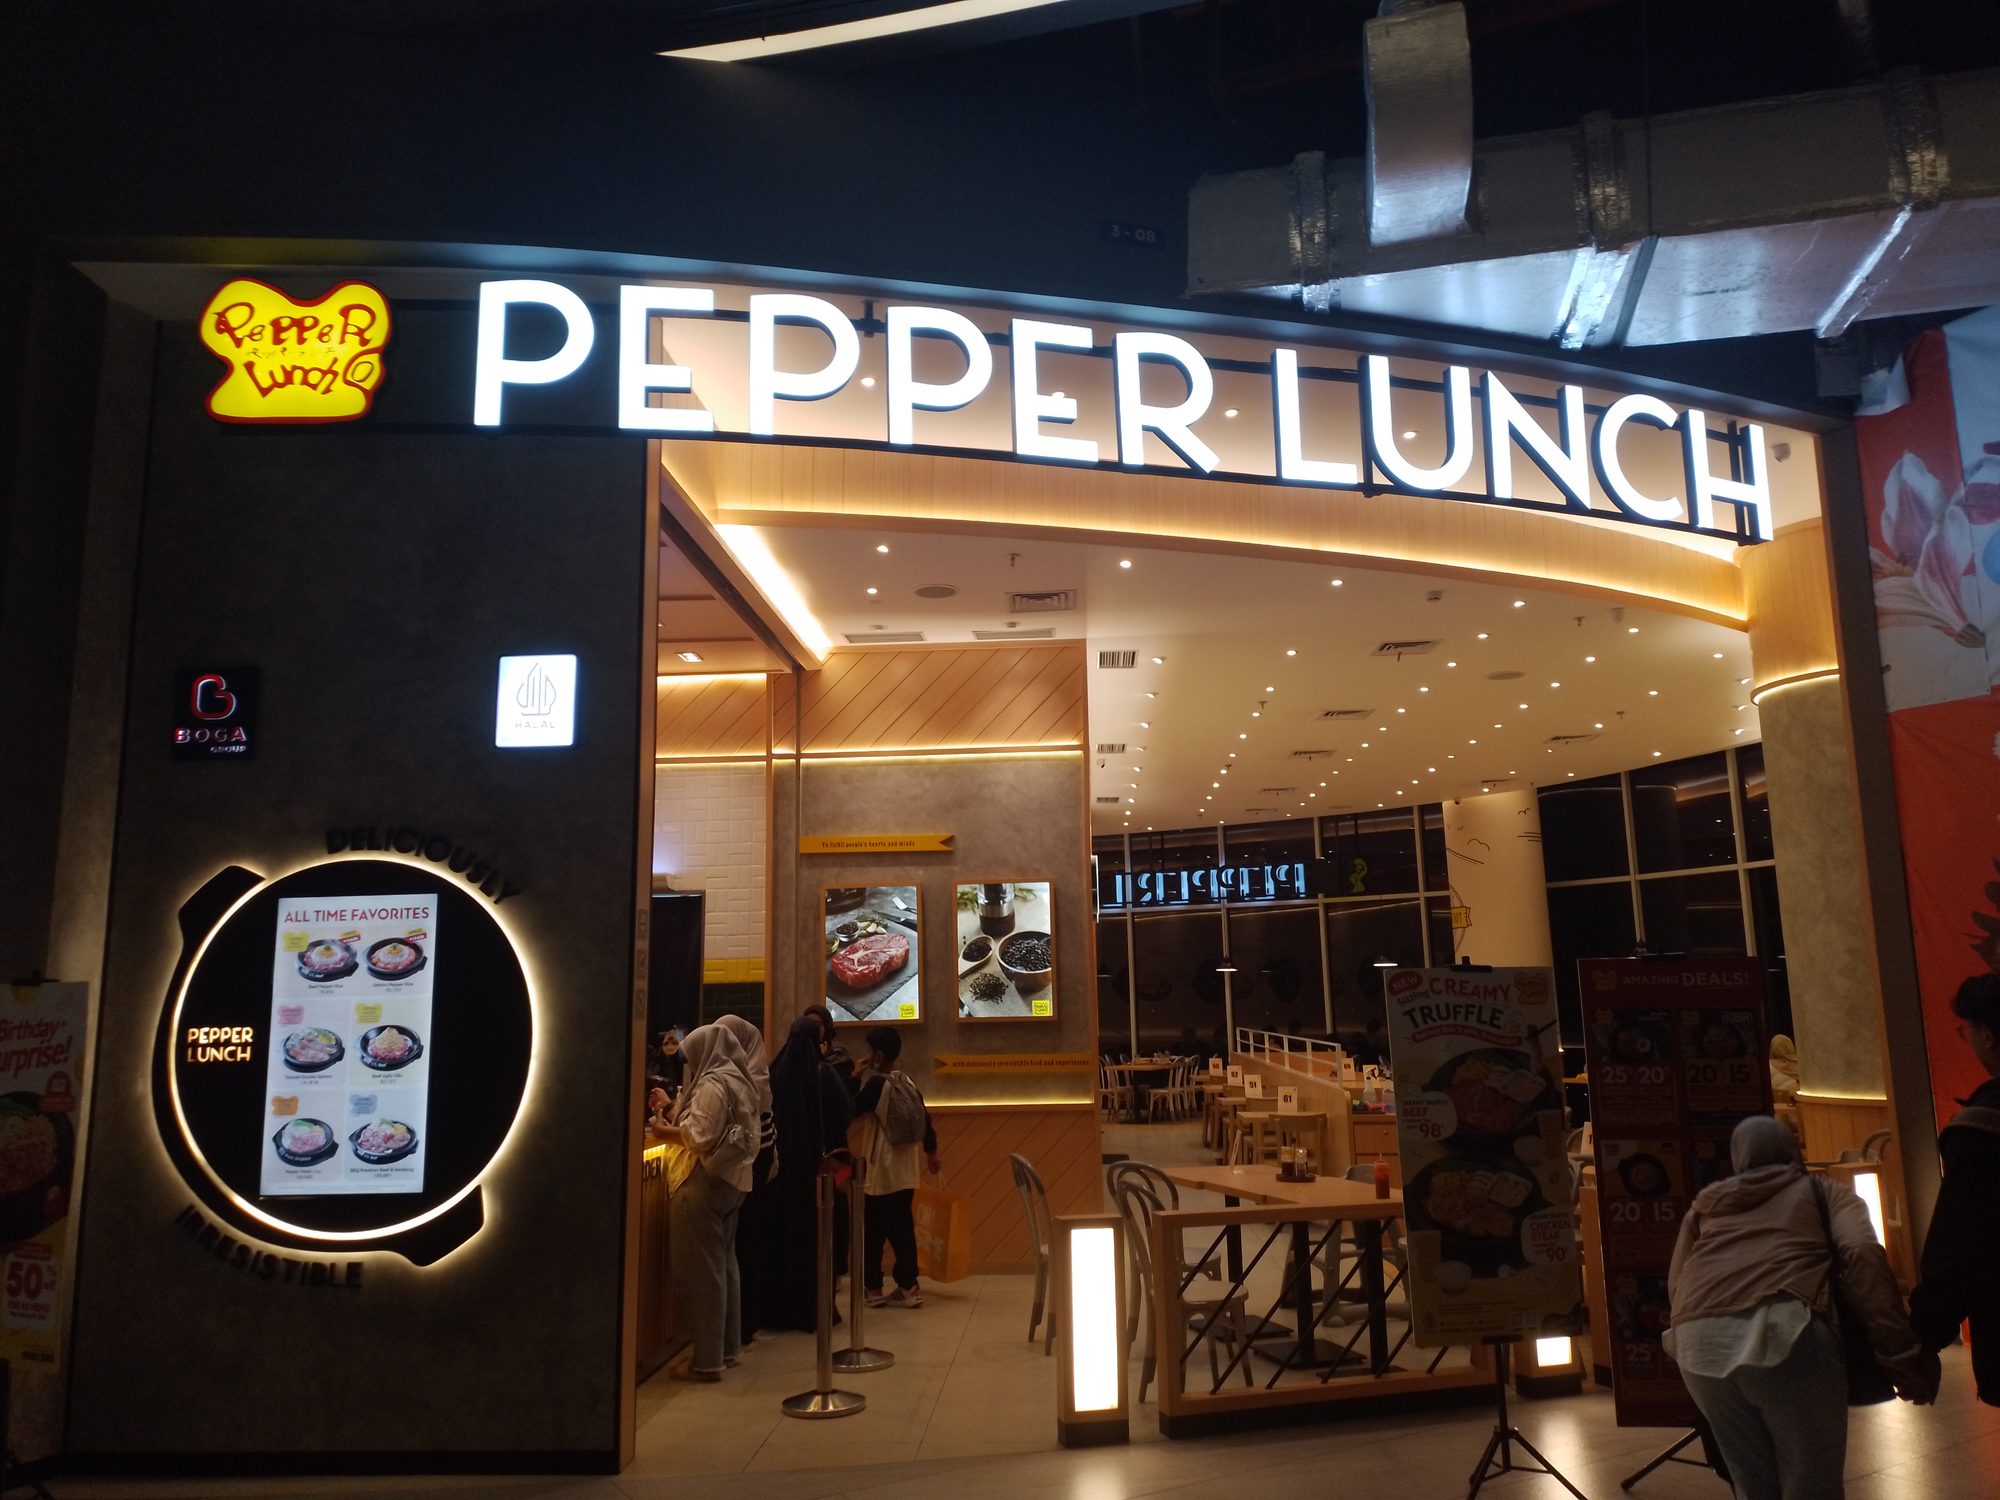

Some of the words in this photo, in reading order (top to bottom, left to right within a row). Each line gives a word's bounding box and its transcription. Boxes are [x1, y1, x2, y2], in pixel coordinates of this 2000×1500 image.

[244, 357, 340, 398] Lunch
[474, 279, 1221, 475] PEPPER
[1272, 347, 1774, 541] LUNCH
[515, 720, 556, 729] HALAL
[174, 726, 247, 744] BOGA
[325, 826, 521, 905] DELICIOUSLY
[284, 911, 310, 923] ALL
[314, 910, 348, 922] TIME
[351, 907, 430, 921] FAVORITES
[1391, 974, 1418, 993] NEW
[1623, 975, 1680, 985] AMAZING
[1681, 971, 1750, 987] DEALS!
[1397, 990, 1431, 1007] Sizzling
[1429, 977, 1511, 1001] CREAMY
[1403, 1003, 1504, 1029] TRUFFLE
[187, 1026, 254, 1045] PEPPER
[0, 1035, 73, 1079] urprise!
[187, 1045, 252, 1063] LUNCH
[1403, 1107, 1428, 1117] BEEF
[175, 1203, 364, 1287] IRRESISTIBLE
